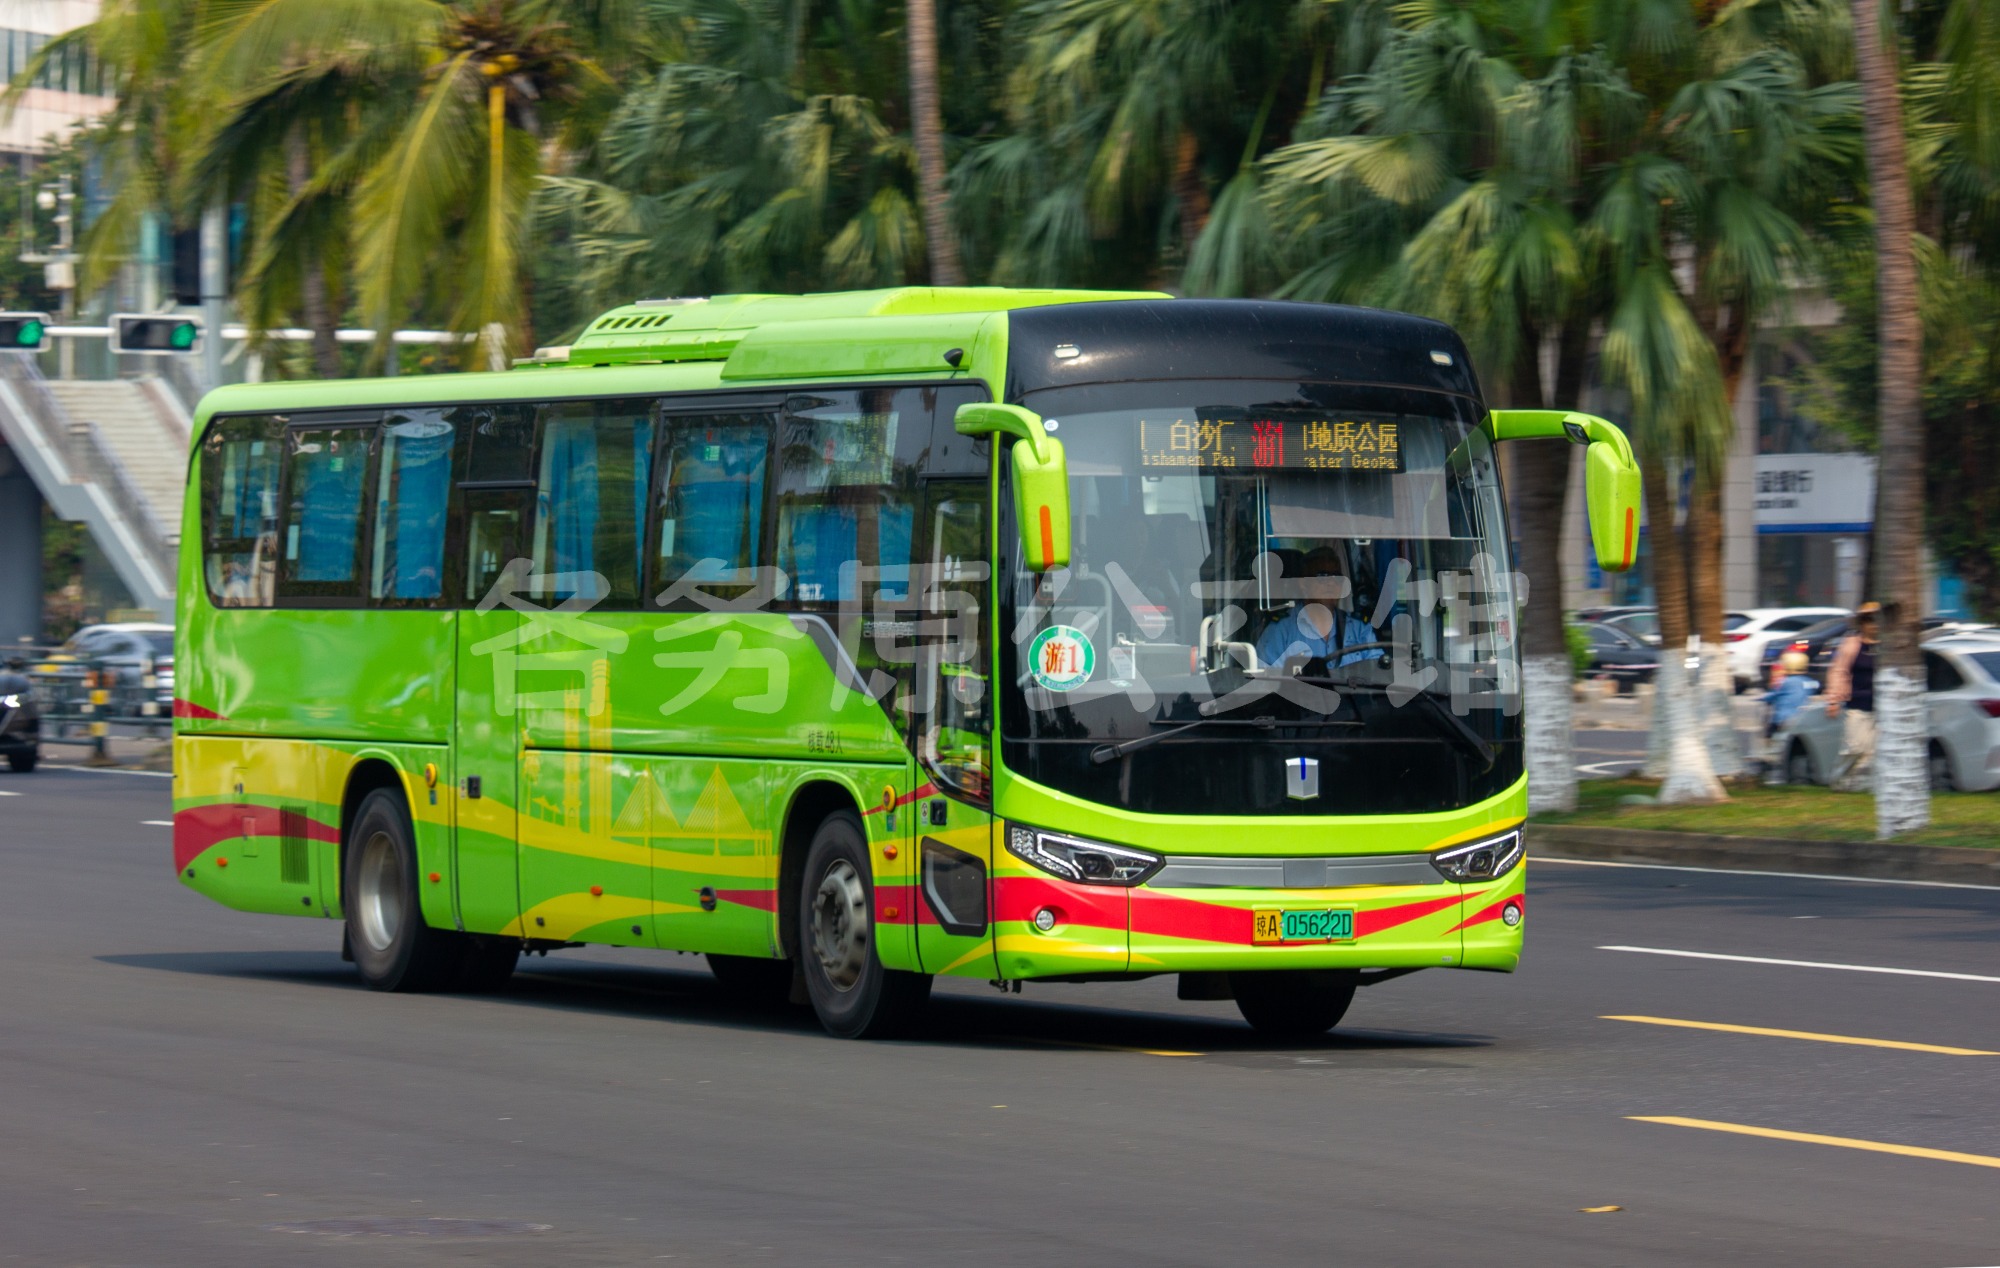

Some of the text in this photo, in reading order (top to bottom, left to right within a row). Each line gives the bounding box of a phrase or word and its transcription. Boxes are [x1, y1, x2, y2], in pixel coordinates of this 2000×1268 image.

[1303, 421, 1398, 453] 地质公园
[1304, 453, 1398, 469] ater GeoPa
[1045, 641, 1080, 675] 游1
